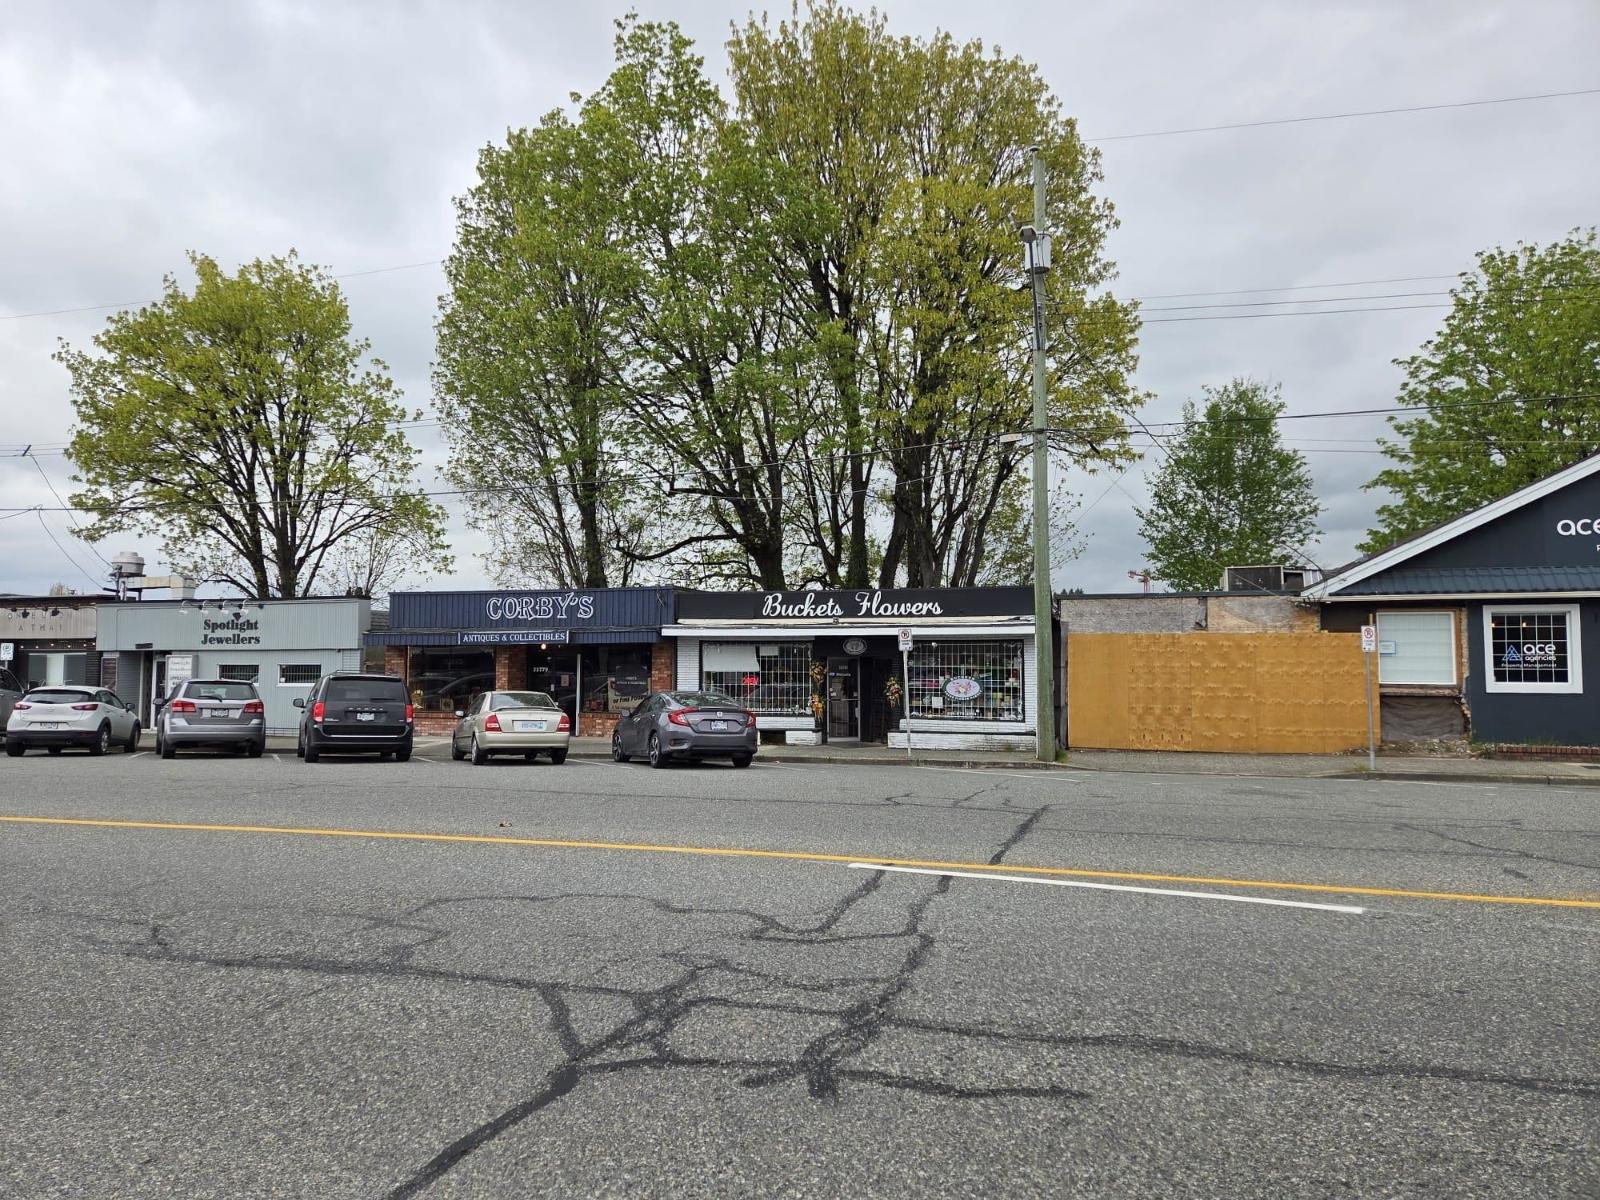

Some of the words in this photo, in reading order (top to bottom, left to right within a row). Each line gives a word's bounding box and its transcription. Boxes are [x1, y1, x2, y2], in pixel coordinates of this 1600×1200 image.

[486, 592, 594, 620] CORBY'S
[762, 592, 844, 617] Buckets
[855, 590, 943, 616] Flowers
[203, 619, 259, 633] Spotlight
[200, 633, 261, 645] Jewellers
[462, 634, 500, 642] ANTIQUES
[509, 632, 566, 641] COLLECTIBLES
[1523, 643, 1556, 654] ace
[1524, 654, 1557, 662] agencies
